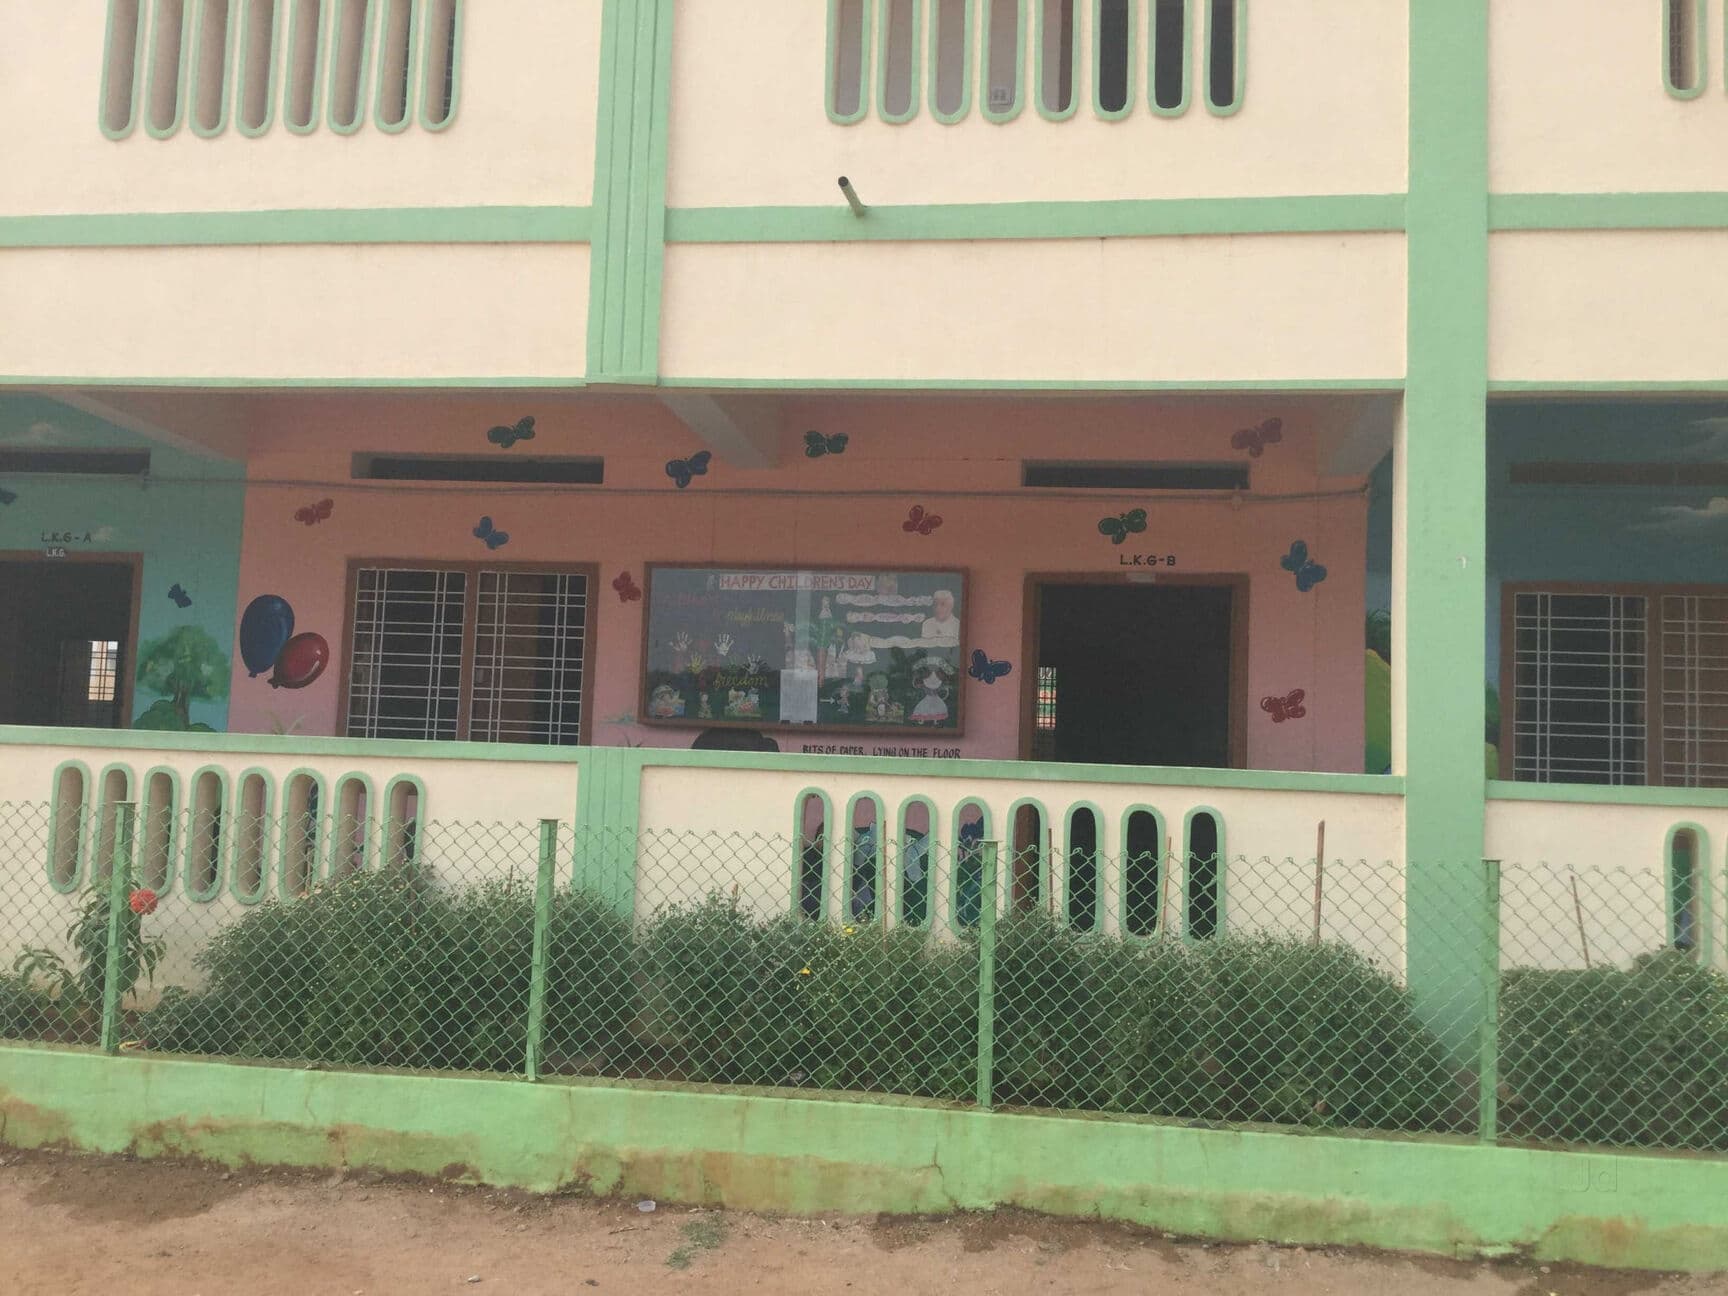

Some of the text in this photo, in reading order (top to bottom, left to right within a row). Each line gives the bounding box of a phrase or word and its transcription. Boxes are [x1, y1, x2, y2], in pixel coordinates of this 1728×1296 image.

[721, 574, 764, 590] HAPPY
[847, 576, 874, 590] DAY
[802, 744, 824, 755] BITS
[825, 745, 837, 755] OF
[898, 747, 910, 758] ON
[911, 747, 928, 758] THE
[932, 748, 961, 759] FLOOR
